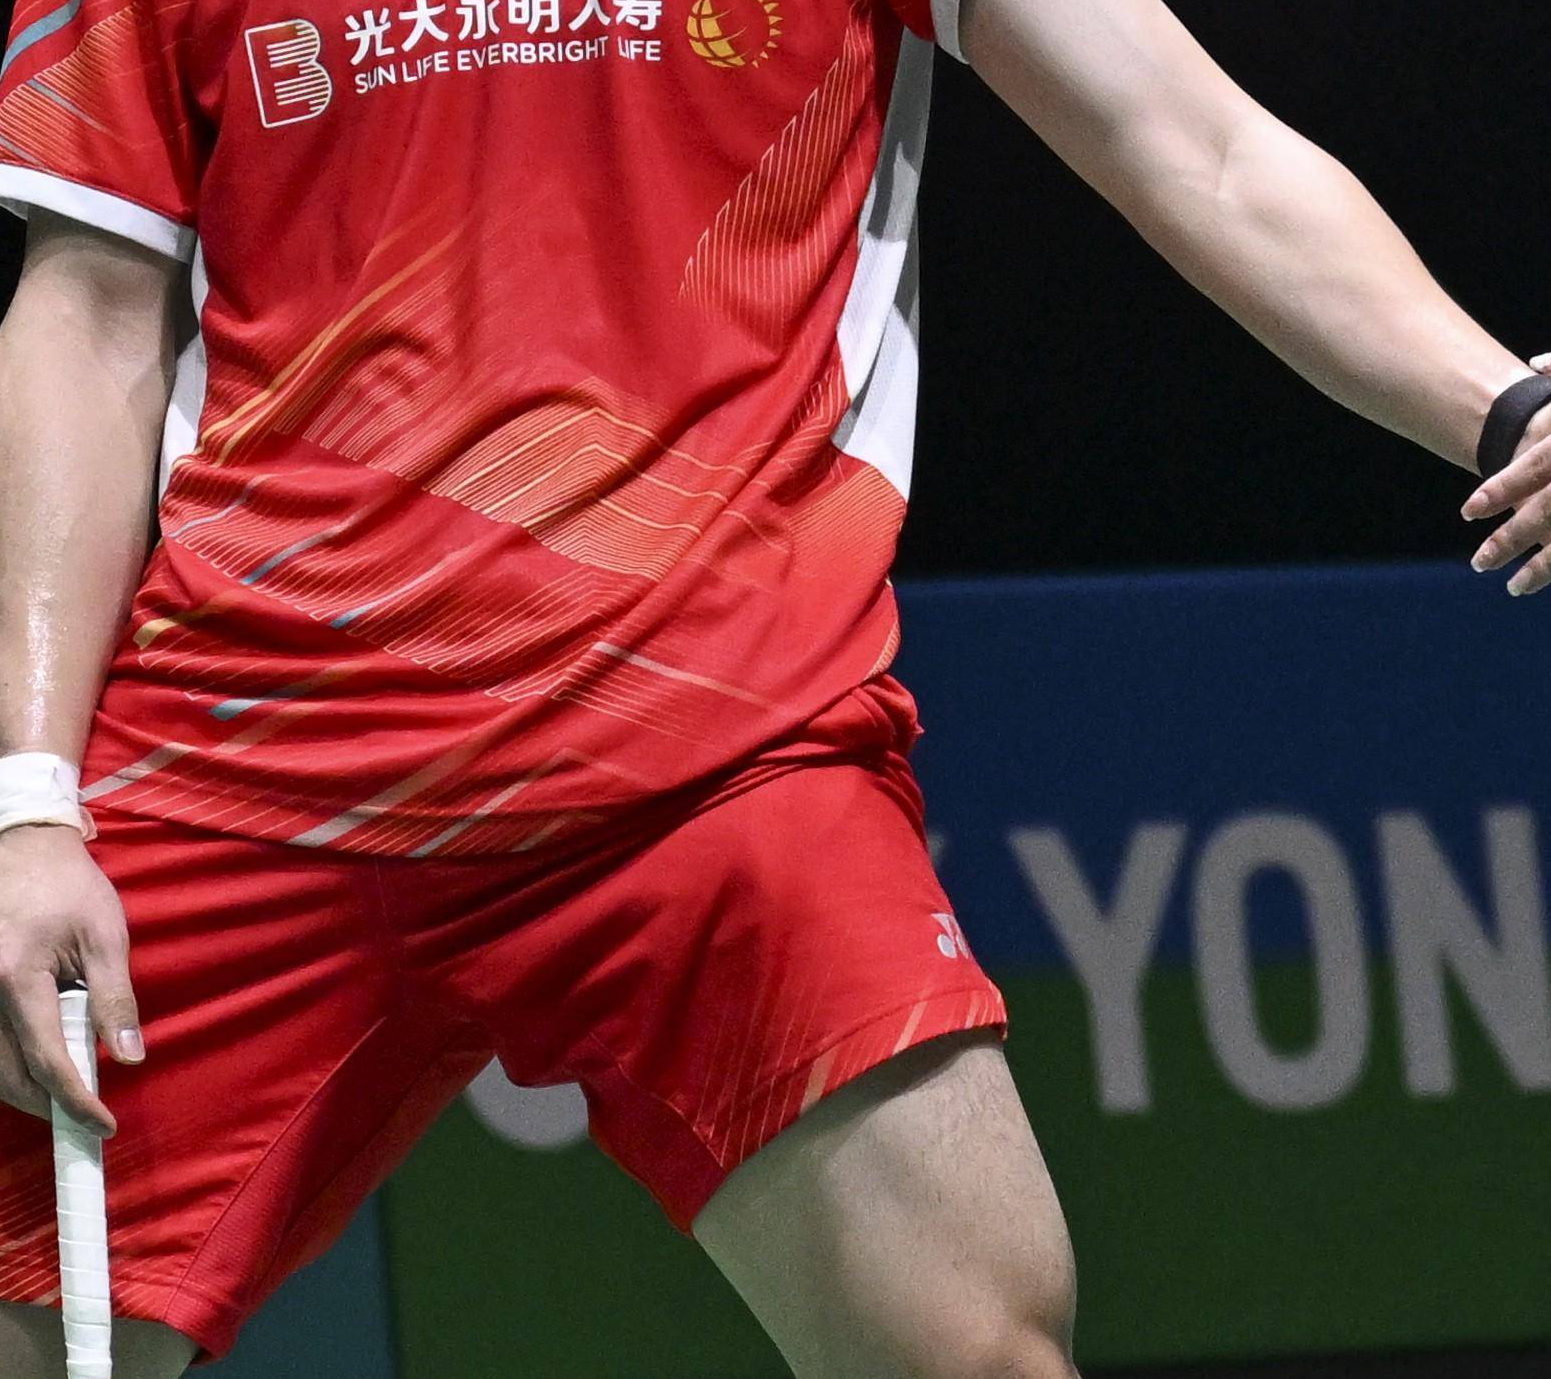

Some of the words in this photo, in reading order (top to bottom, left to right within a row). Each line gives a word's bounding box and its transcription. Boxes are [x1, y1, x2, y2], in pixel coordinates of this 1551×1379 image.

[355, 63, 398, 95] SUN
[402, 50, 451, 83] LIFE
[456, 35, 609, 72] EVERBRIGHT
[618, 39, 662, 62] LIFE
